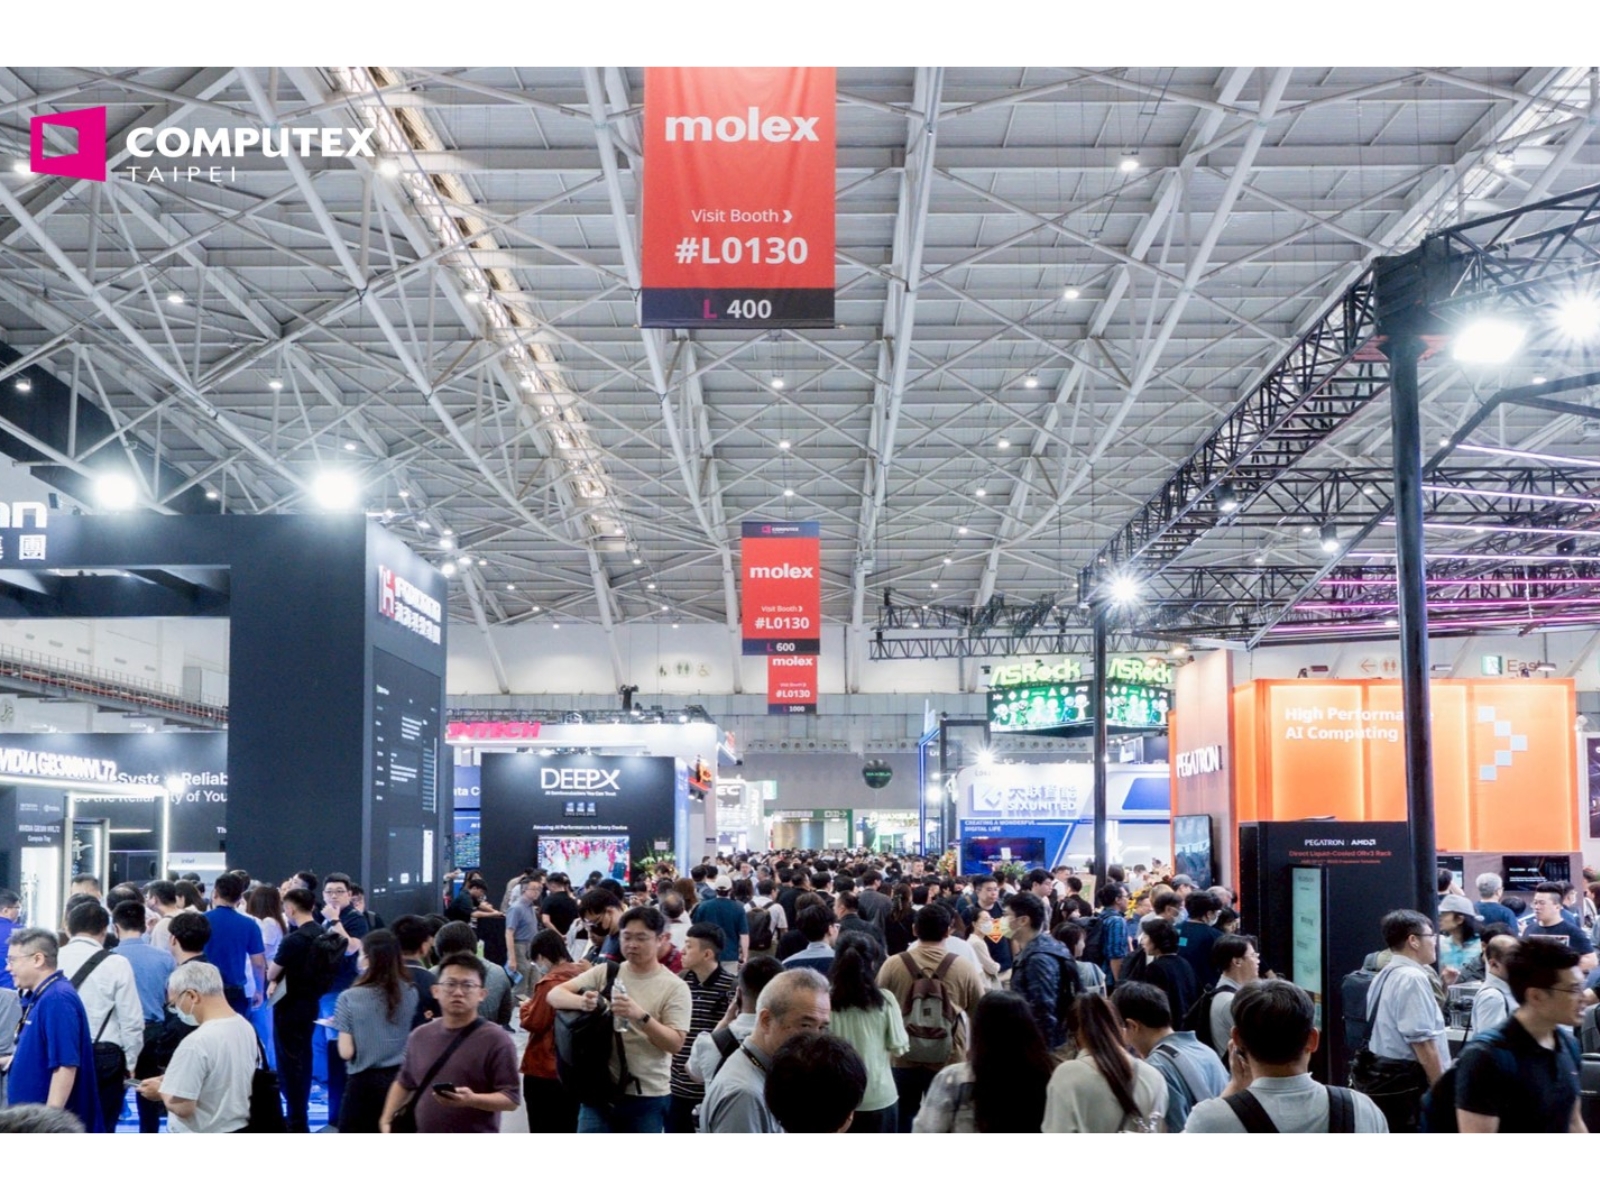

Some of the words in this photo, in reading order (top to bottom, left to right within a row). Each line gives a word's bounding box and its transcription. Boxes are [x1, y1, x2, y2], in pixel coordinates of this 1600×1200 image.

[665, 106, 820, 142] molex
[691, 209, 725, 223] Visit
[730, 209, 779, 223] Booth
[674, 236, 809, 265] #L0130
[703, 298, 718, 319] L
[726, 299, 772, 319] 400
[749, 563, 814, 579] molex
[755, 617, 810, 630] #L0130
[766, 643, 773, 651] L
[776, 642, 796, 652] 600
[772, 656, 813, 666] molex
[989, 658, 1081, 686] ASRock
[1107, 657, 1172, 684] ASRock
[776, 689, 811, 698] #L0130
[1285, 707, 1323, 722] High
[1285, 727, 1303, 739] AI
[1308, 726, 1399, 742] Computing
[1176, 744, 1220, 779] PEGATRON
[540, 767, 621, 790] DEEPX
[187, 791, 201, 803] of
